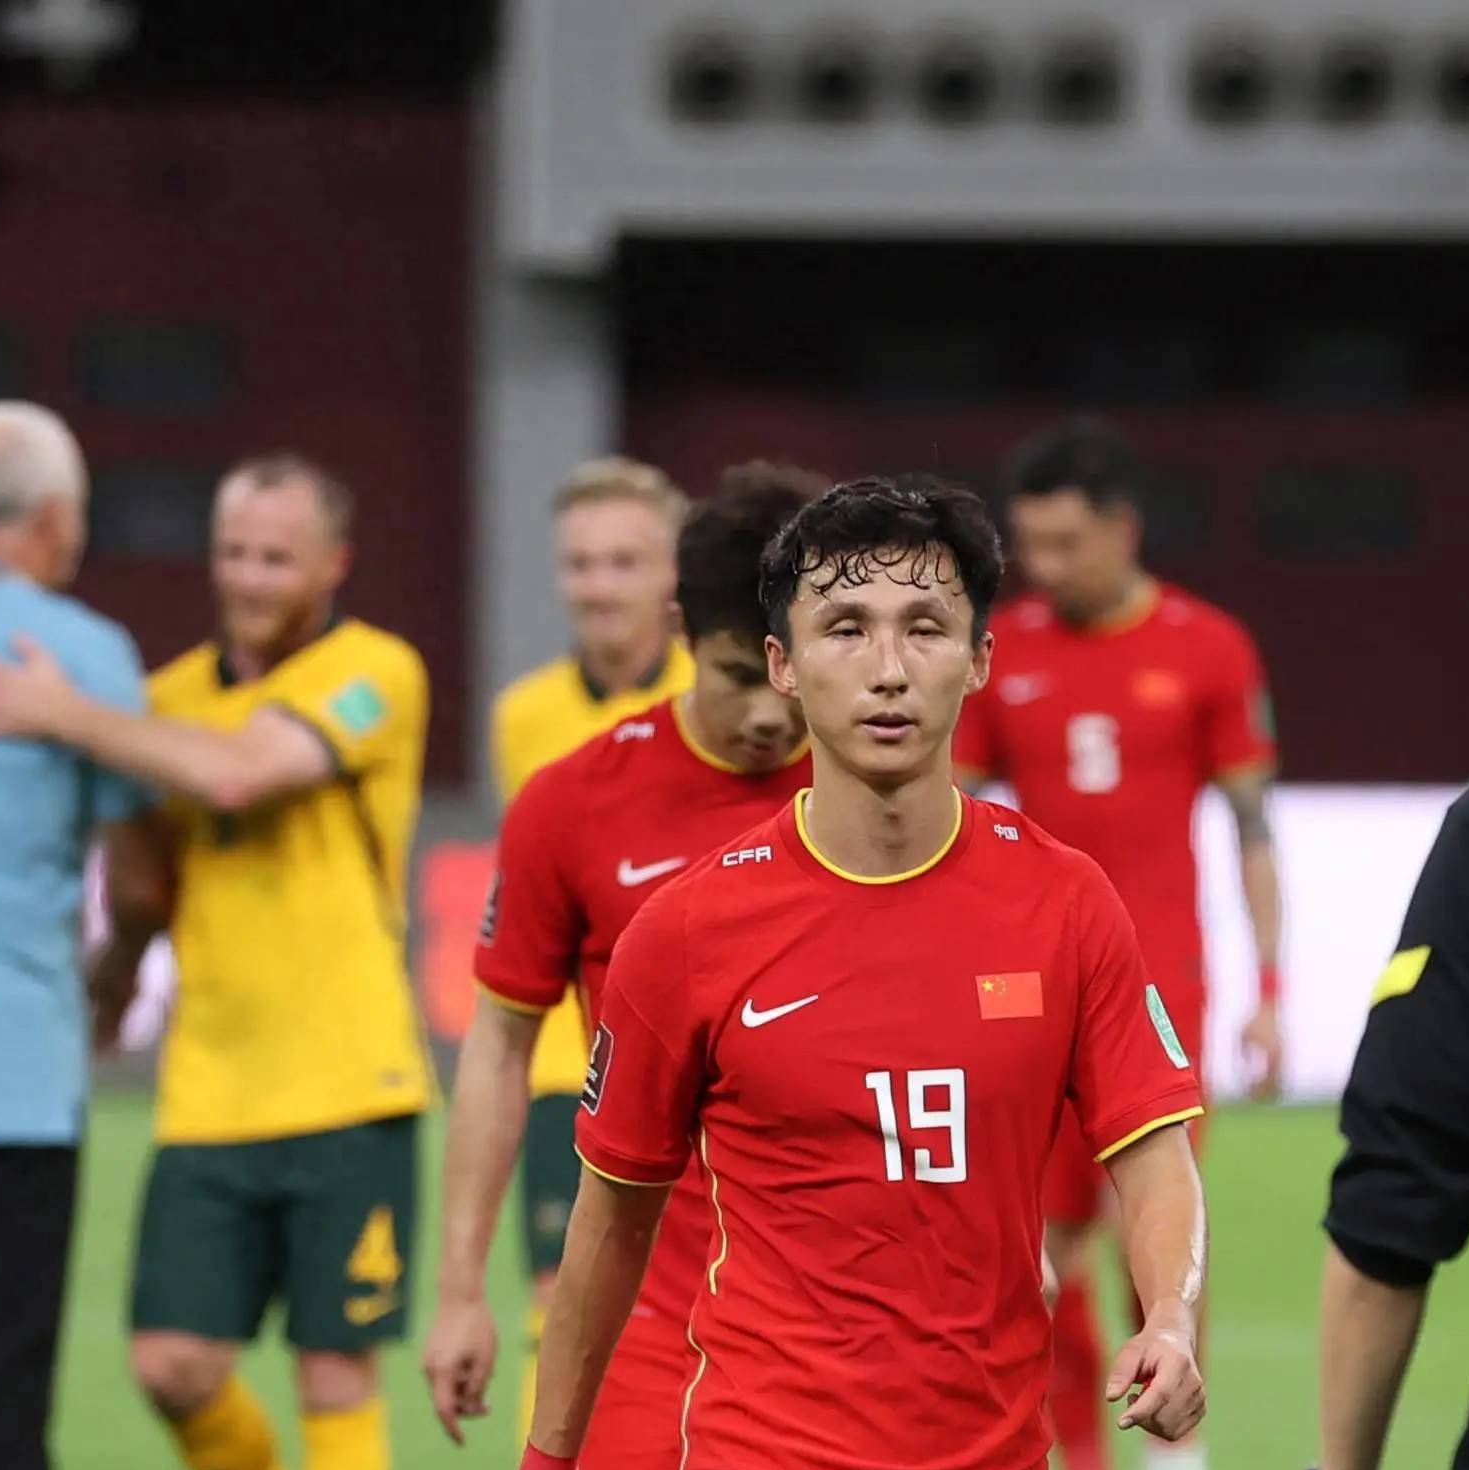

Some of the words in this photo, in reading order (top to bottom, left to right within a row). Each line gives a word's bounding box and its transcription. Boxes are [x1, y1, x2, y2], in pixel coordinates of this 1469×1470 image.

[722, 845, 772, 868] CFA
[993, 823, 1019, 841] 中国
[865, 1067, 967, 1183] 19
[347, 1204, 403, 1296] 4
